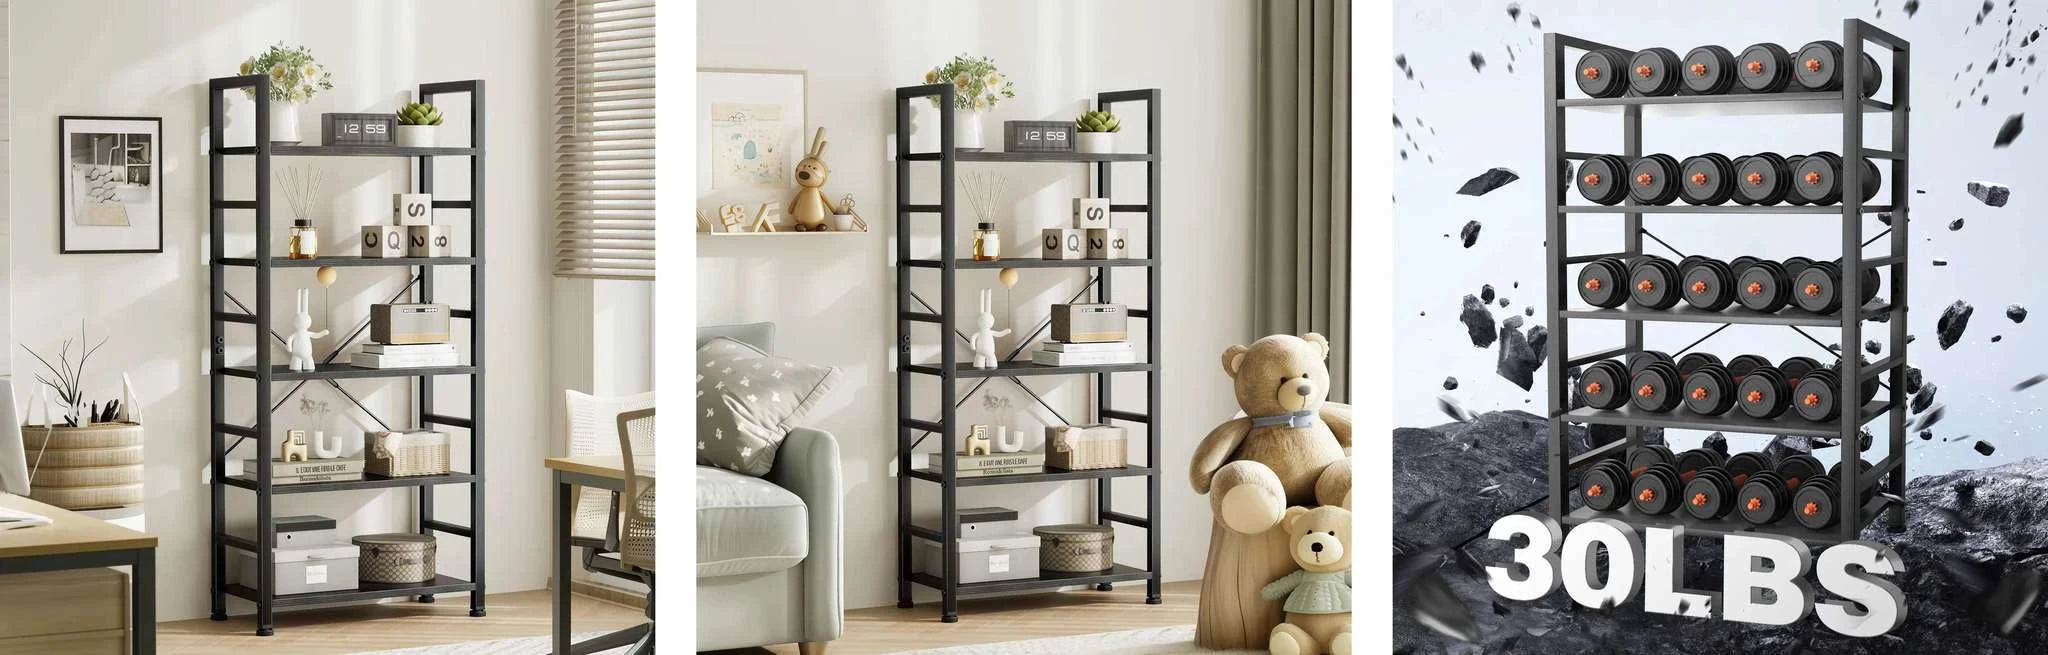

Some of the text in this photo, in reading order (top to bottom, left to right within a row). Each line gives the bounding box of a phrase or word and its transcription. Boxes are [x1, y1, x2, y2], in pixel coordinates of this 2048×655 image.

[344, 123, 386, 134] 12 59
[1025, 131, 1066, 141] 12 59
[407, 203, 426, 218] S
[1086, 207, 1104, 221] S
[387, 231, 401, 250] Q
[411, 235, 425, 248] 2
[434, 235, 448, 248] 8
[1067, 234, 1080, 252] Q
[1090, 238, 1103, 250] 2
[1111, 238, 1125, 250] 8
